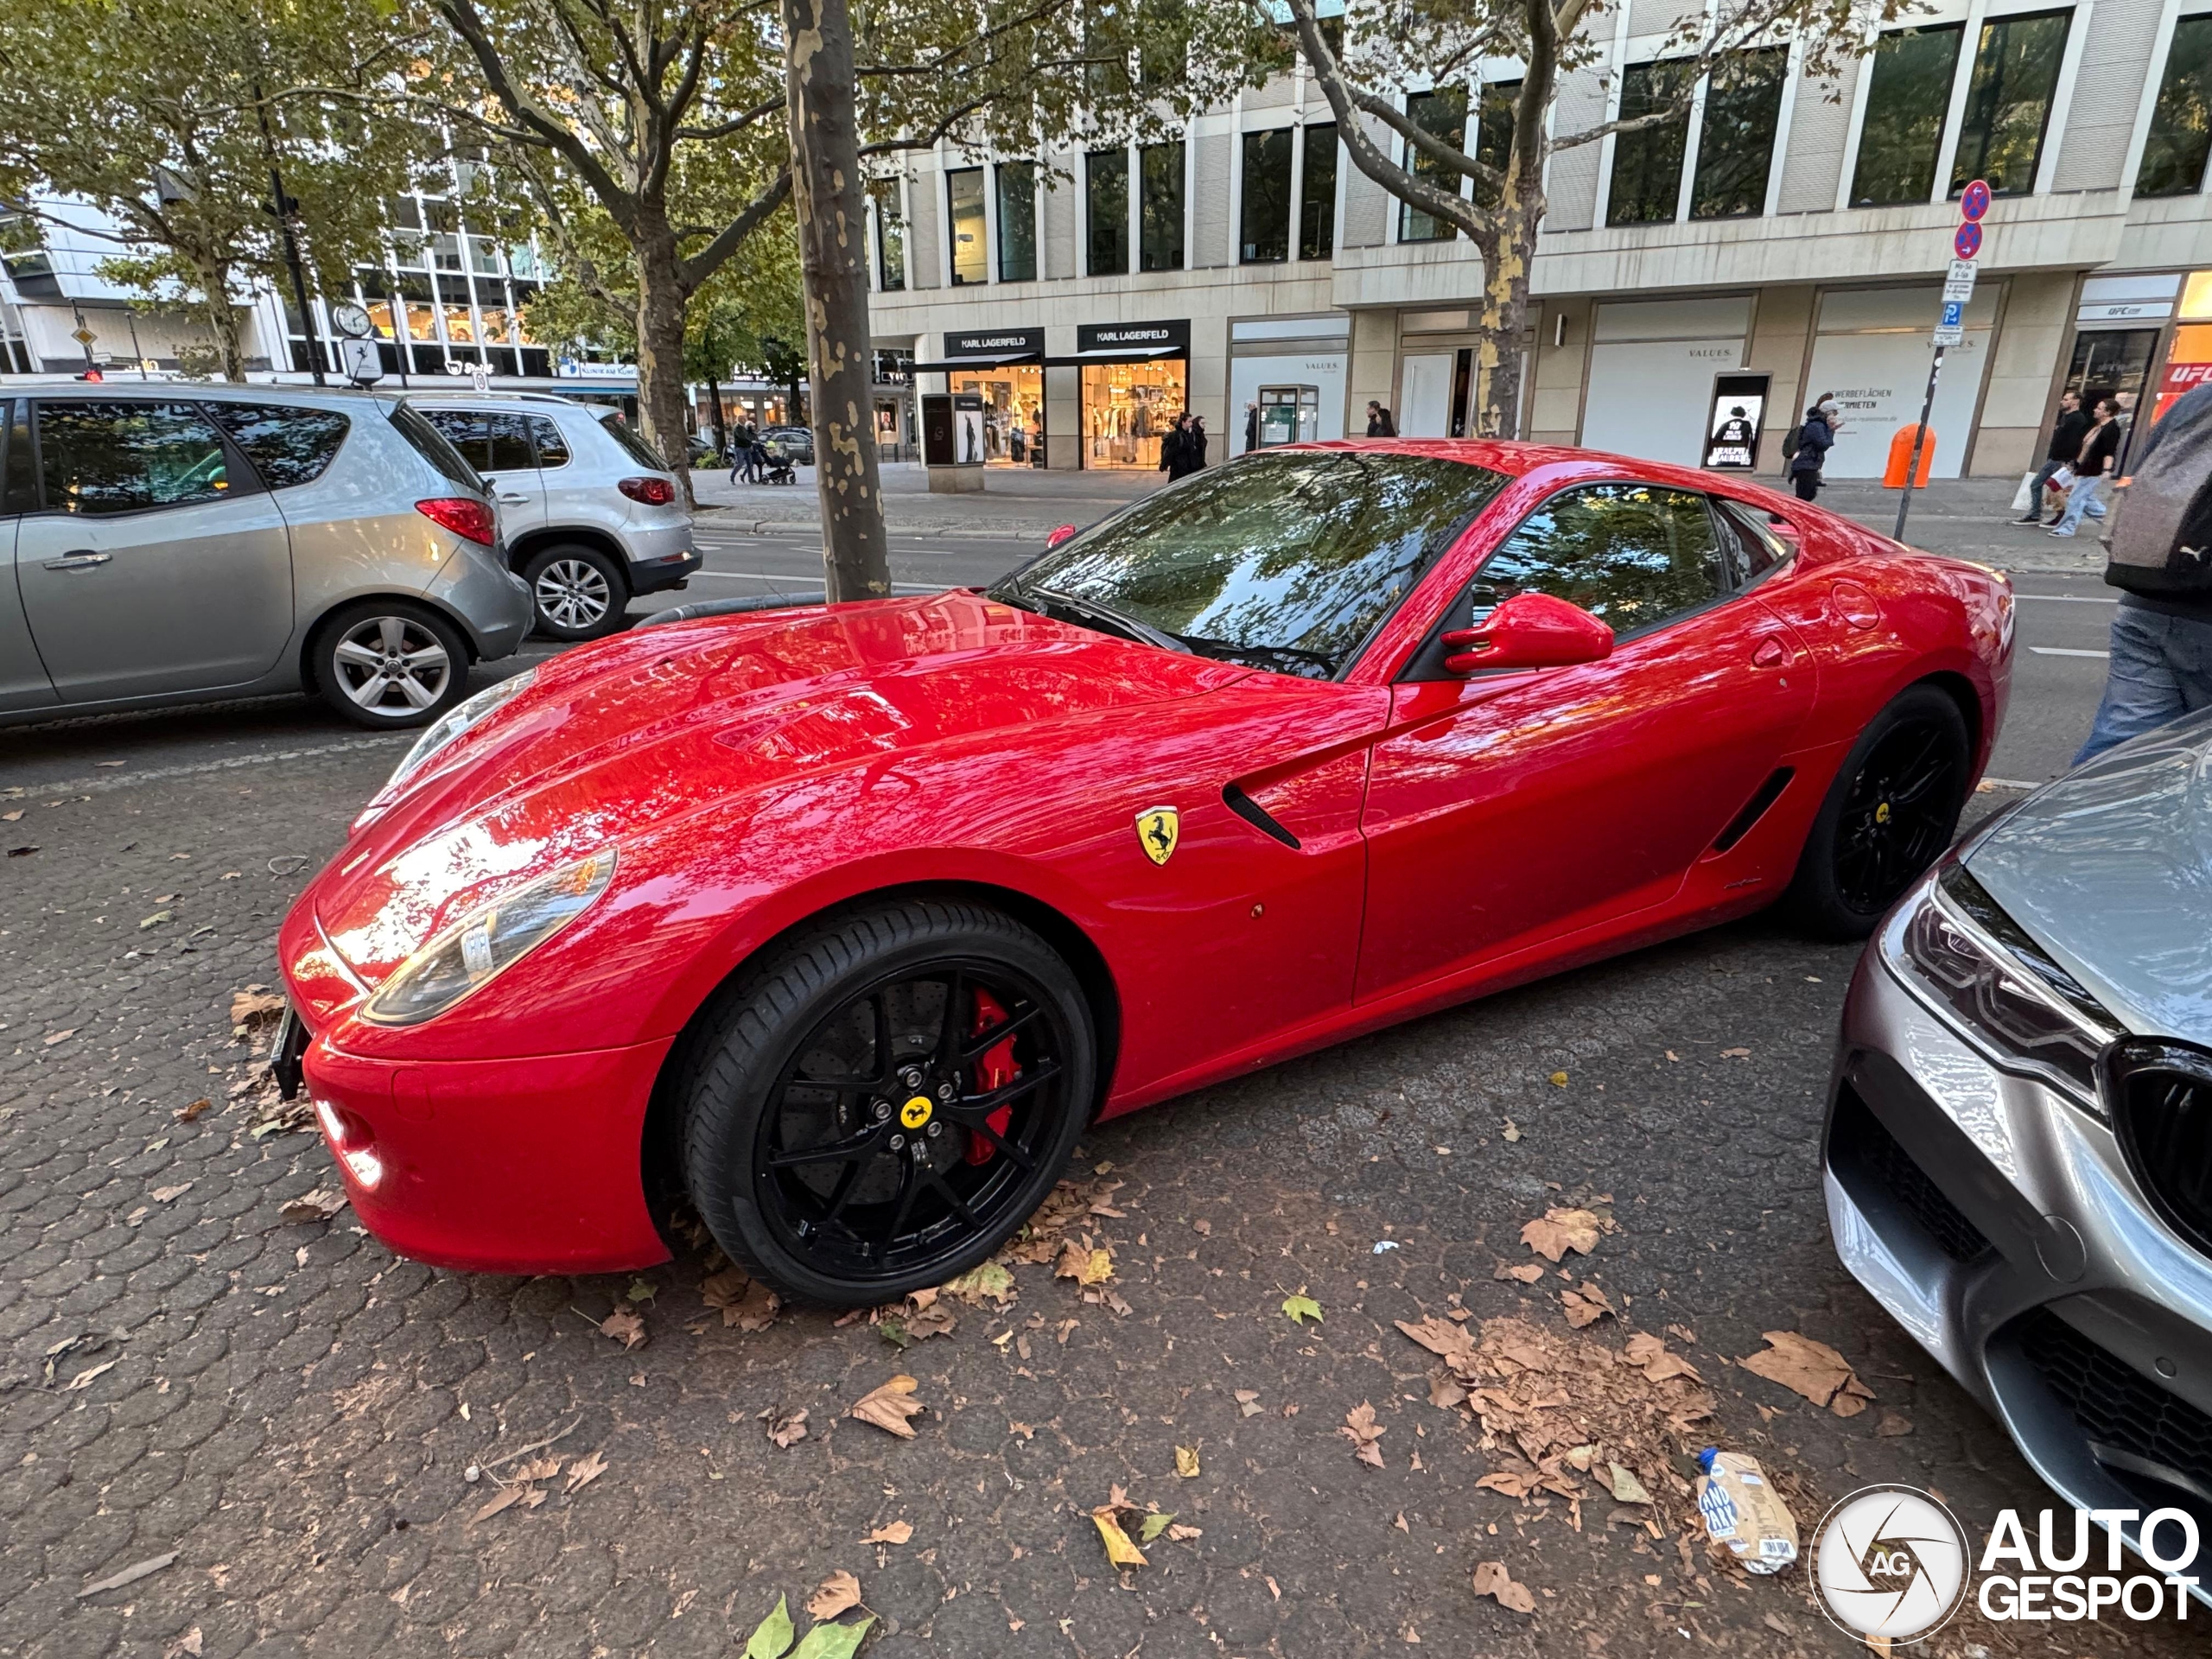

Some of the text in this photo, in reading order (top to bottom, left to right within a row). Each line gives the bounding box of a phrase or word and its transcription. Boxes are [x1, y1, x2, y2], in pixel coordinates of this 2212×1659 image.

[1096, 329, 1169, 341] KARL LAGERFELD
[962, 337, 1026, 348] KARL LAGERFELD
[1828, 388, 1892, 398] WERBEFLÄCHEN
